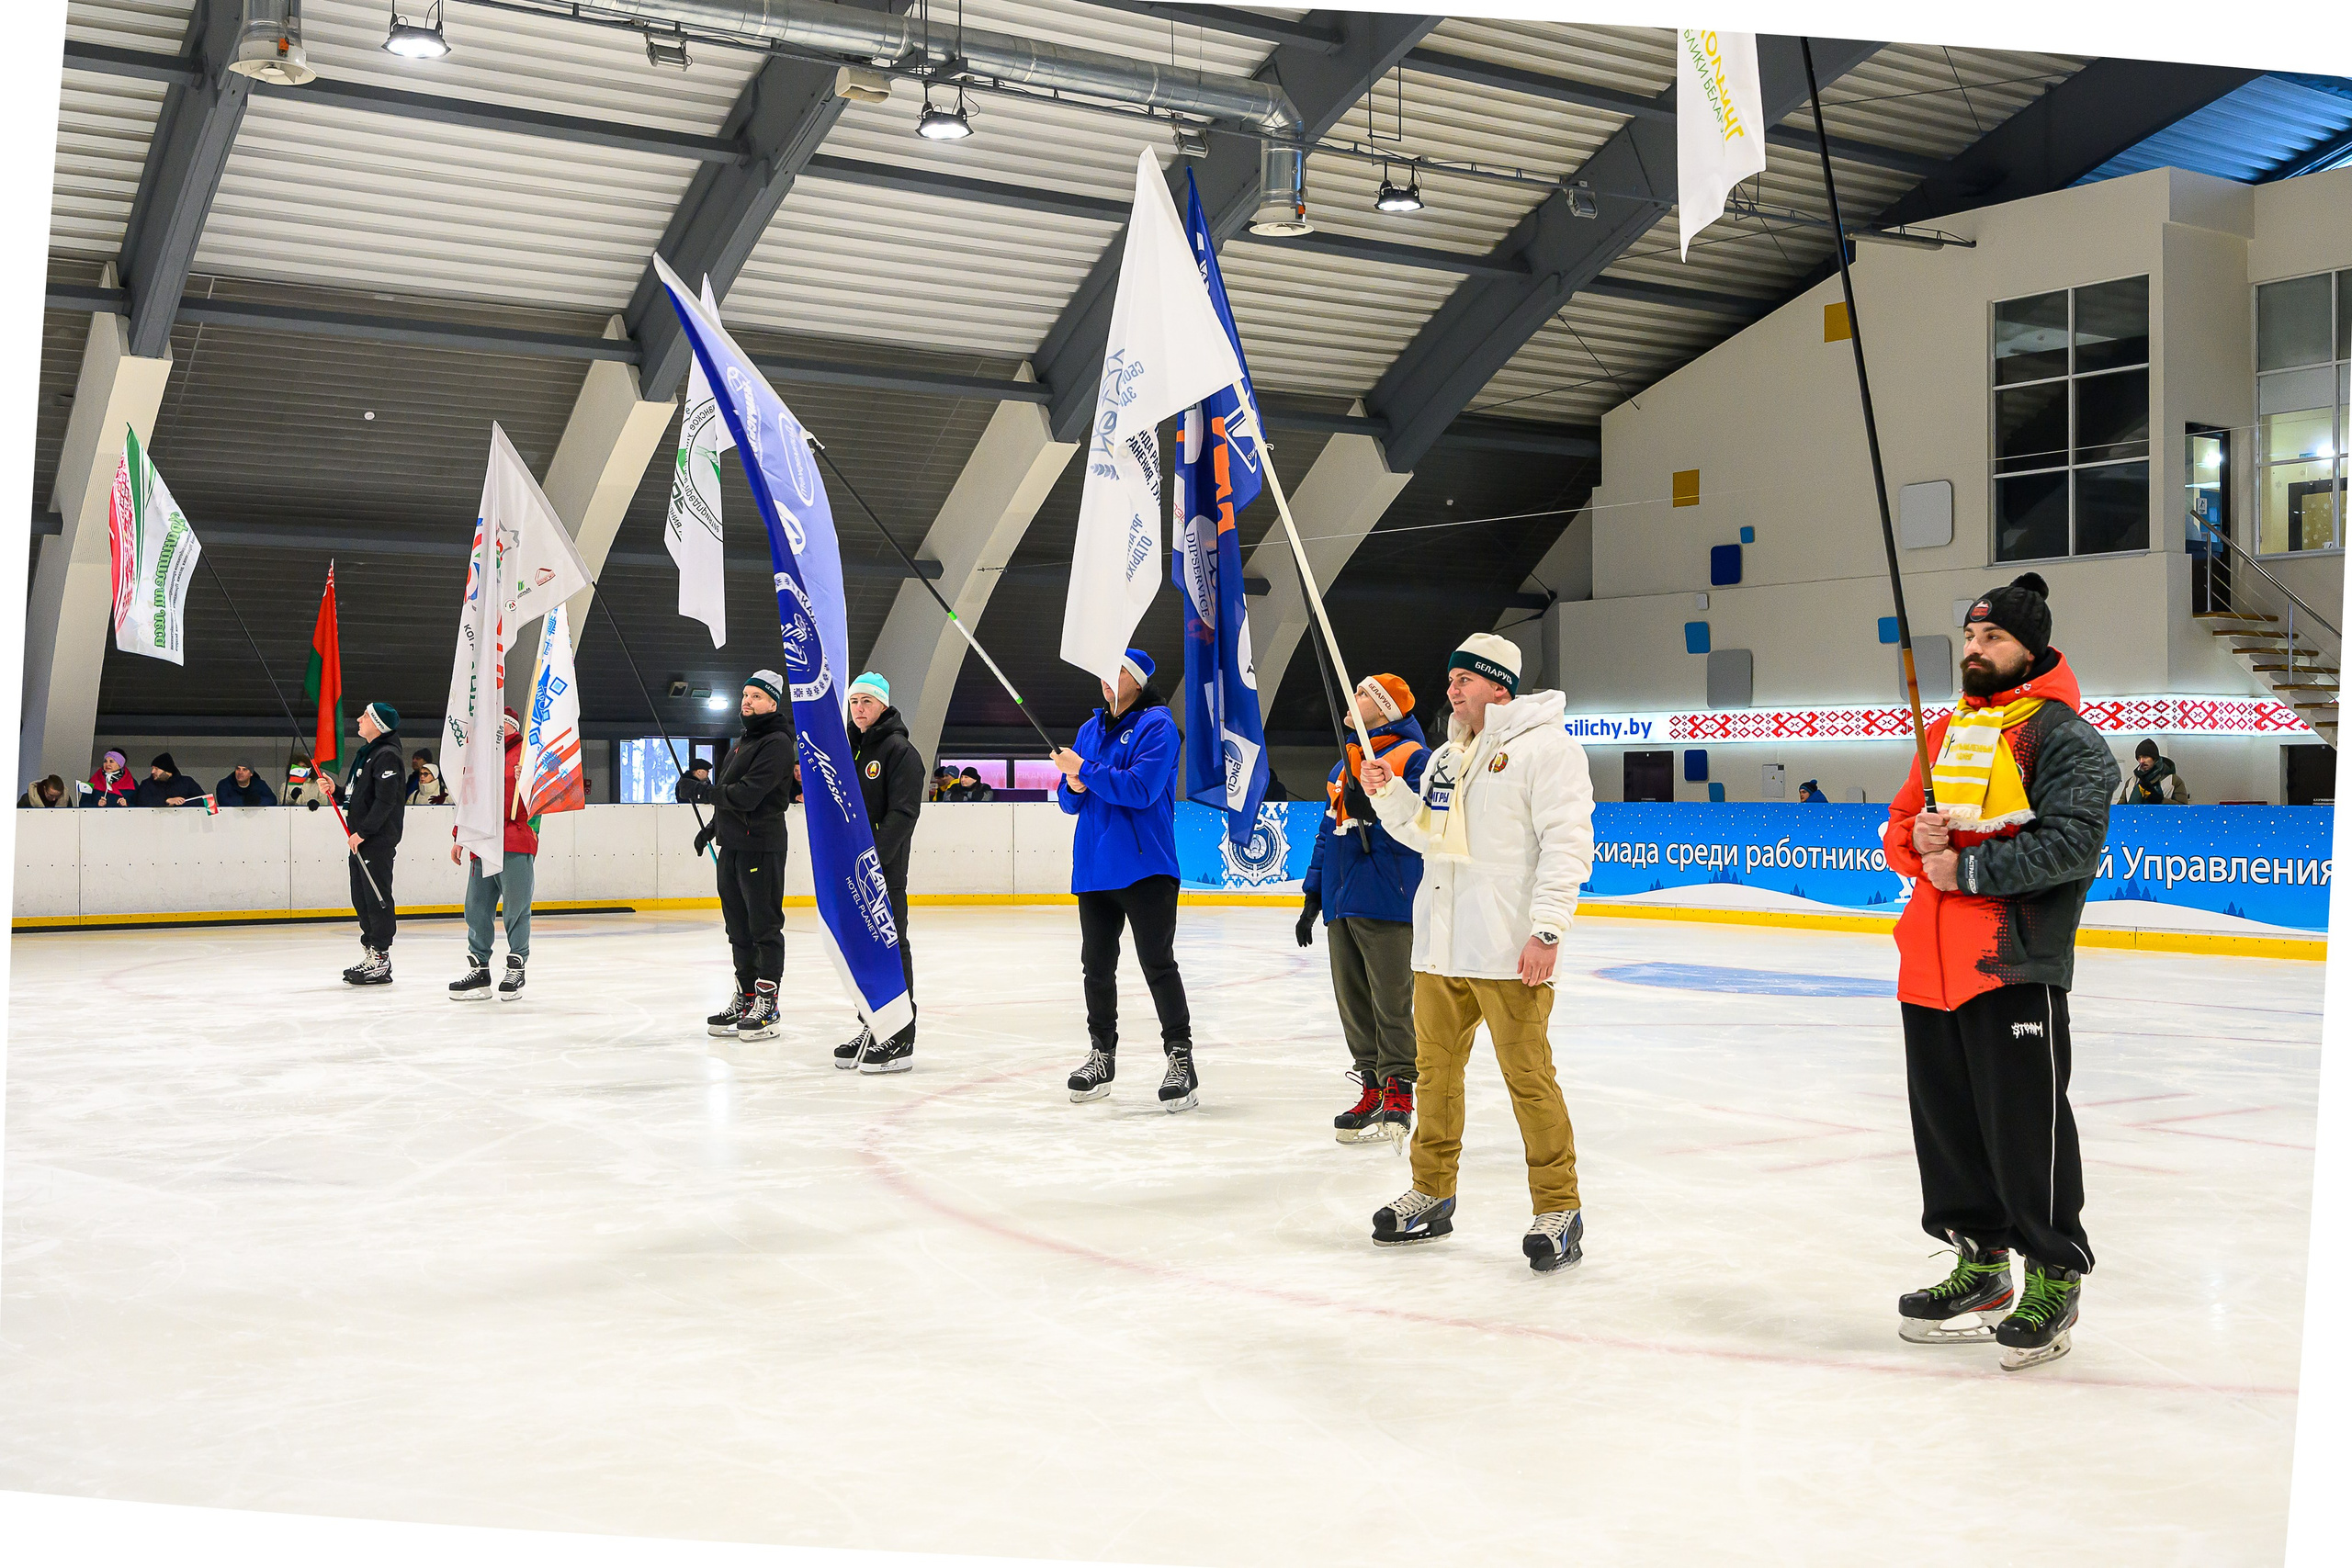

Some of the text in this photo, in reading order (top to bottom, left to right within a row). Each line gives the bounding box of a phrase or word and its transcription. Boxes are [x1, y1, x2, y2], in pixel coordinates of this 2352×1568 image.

[1185, 531, 1211, 618] DIPSERVICE
[1475, 660, 1514, 686] БЕЛАРУСЬ
[1367, 682, 1393, 712] БЕЛАРУСЬ
[1564, 717, 1653, 739] silichy.by
[797, 734, 818, 773] HOTEL
[1666, 841, 1738, 872] среди
[1746, 837, 1891, 874] работнико
[2121, 845, 2334, 890] Управления
[845, 875, 880, 943] HOTEL PLANETA
